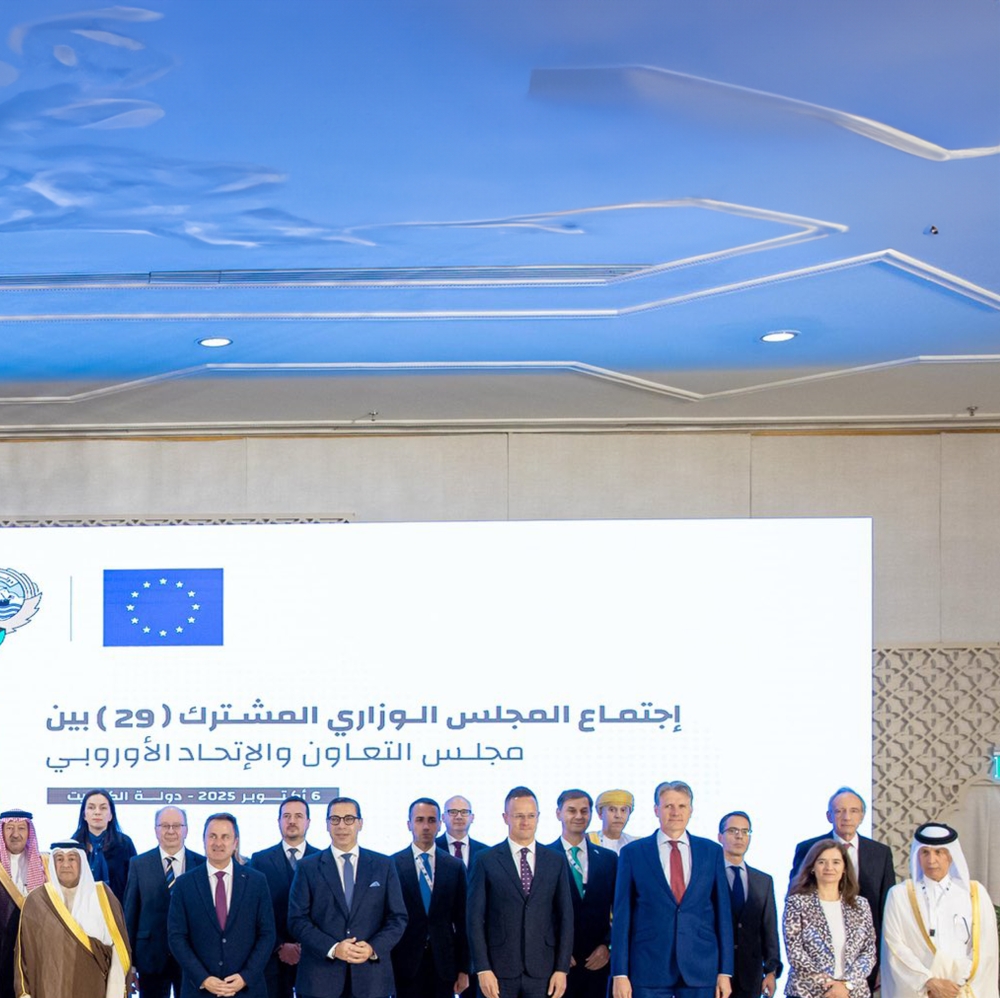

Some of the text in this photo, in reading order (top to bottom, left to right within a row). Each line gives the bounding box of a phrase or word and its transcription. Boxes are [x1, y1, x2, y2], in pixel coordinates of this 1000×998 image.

[45, 704, 89, 732] بين
[178, 698, 318, 732] المشترك
[327, 702, 438, 737] الوزاري
[446, 705, 570, 731] المجلس
[578, 701, 682, 733] إجتماع
[45, 735, 524, 773] مجلس التعاون والإتحاد الأوروبي
[134, 790, 182, 803] دولة
[198, 791, 236, 801] 2025
[311, 791, 321, 801] 6
